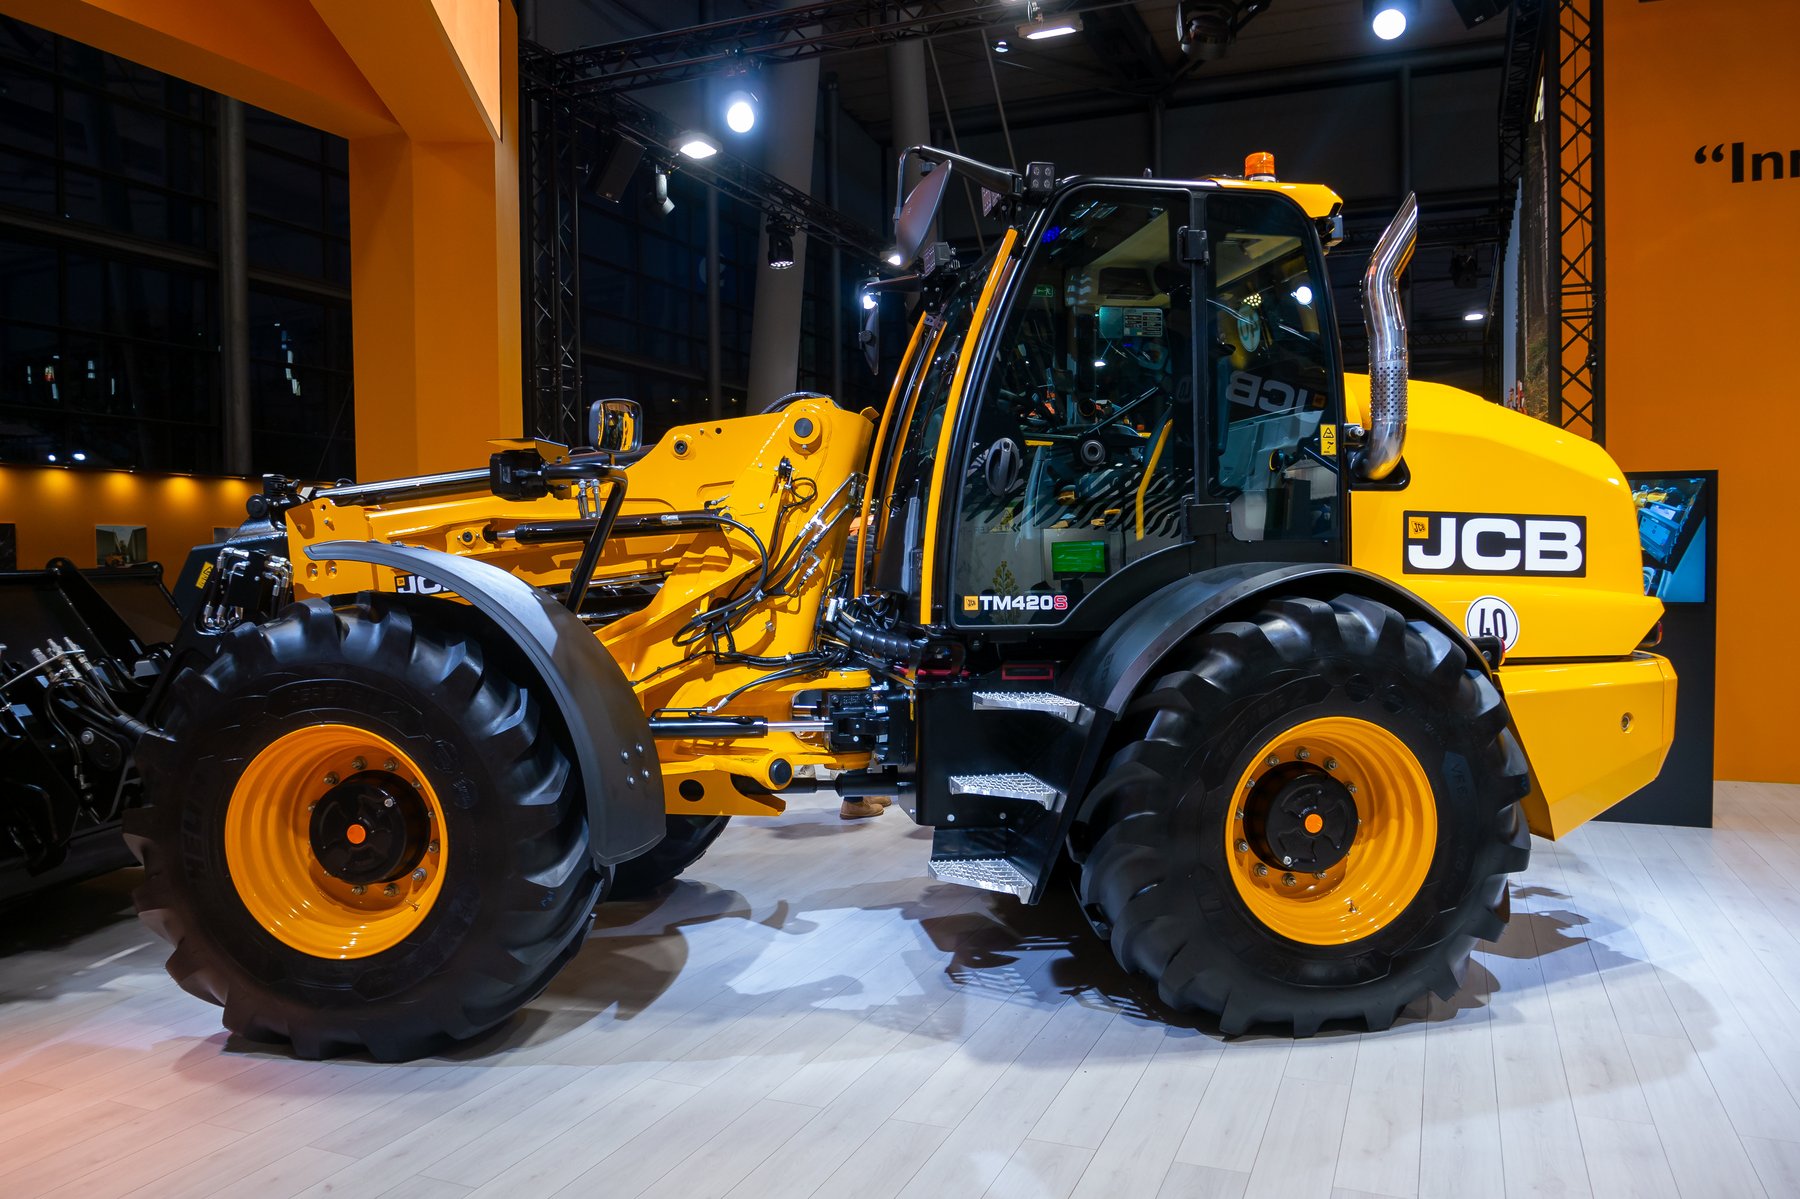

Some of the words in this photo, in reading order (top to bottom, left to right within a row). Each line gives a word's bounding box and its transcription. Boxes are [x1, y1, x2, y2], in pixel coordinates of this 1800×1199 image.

[1408, 517, 1583, 572] JCB
[397, 575, 450, 595] JC
[979, 595, 1068, 611] TM420S
[1479, 607, 1508, 641] 40
